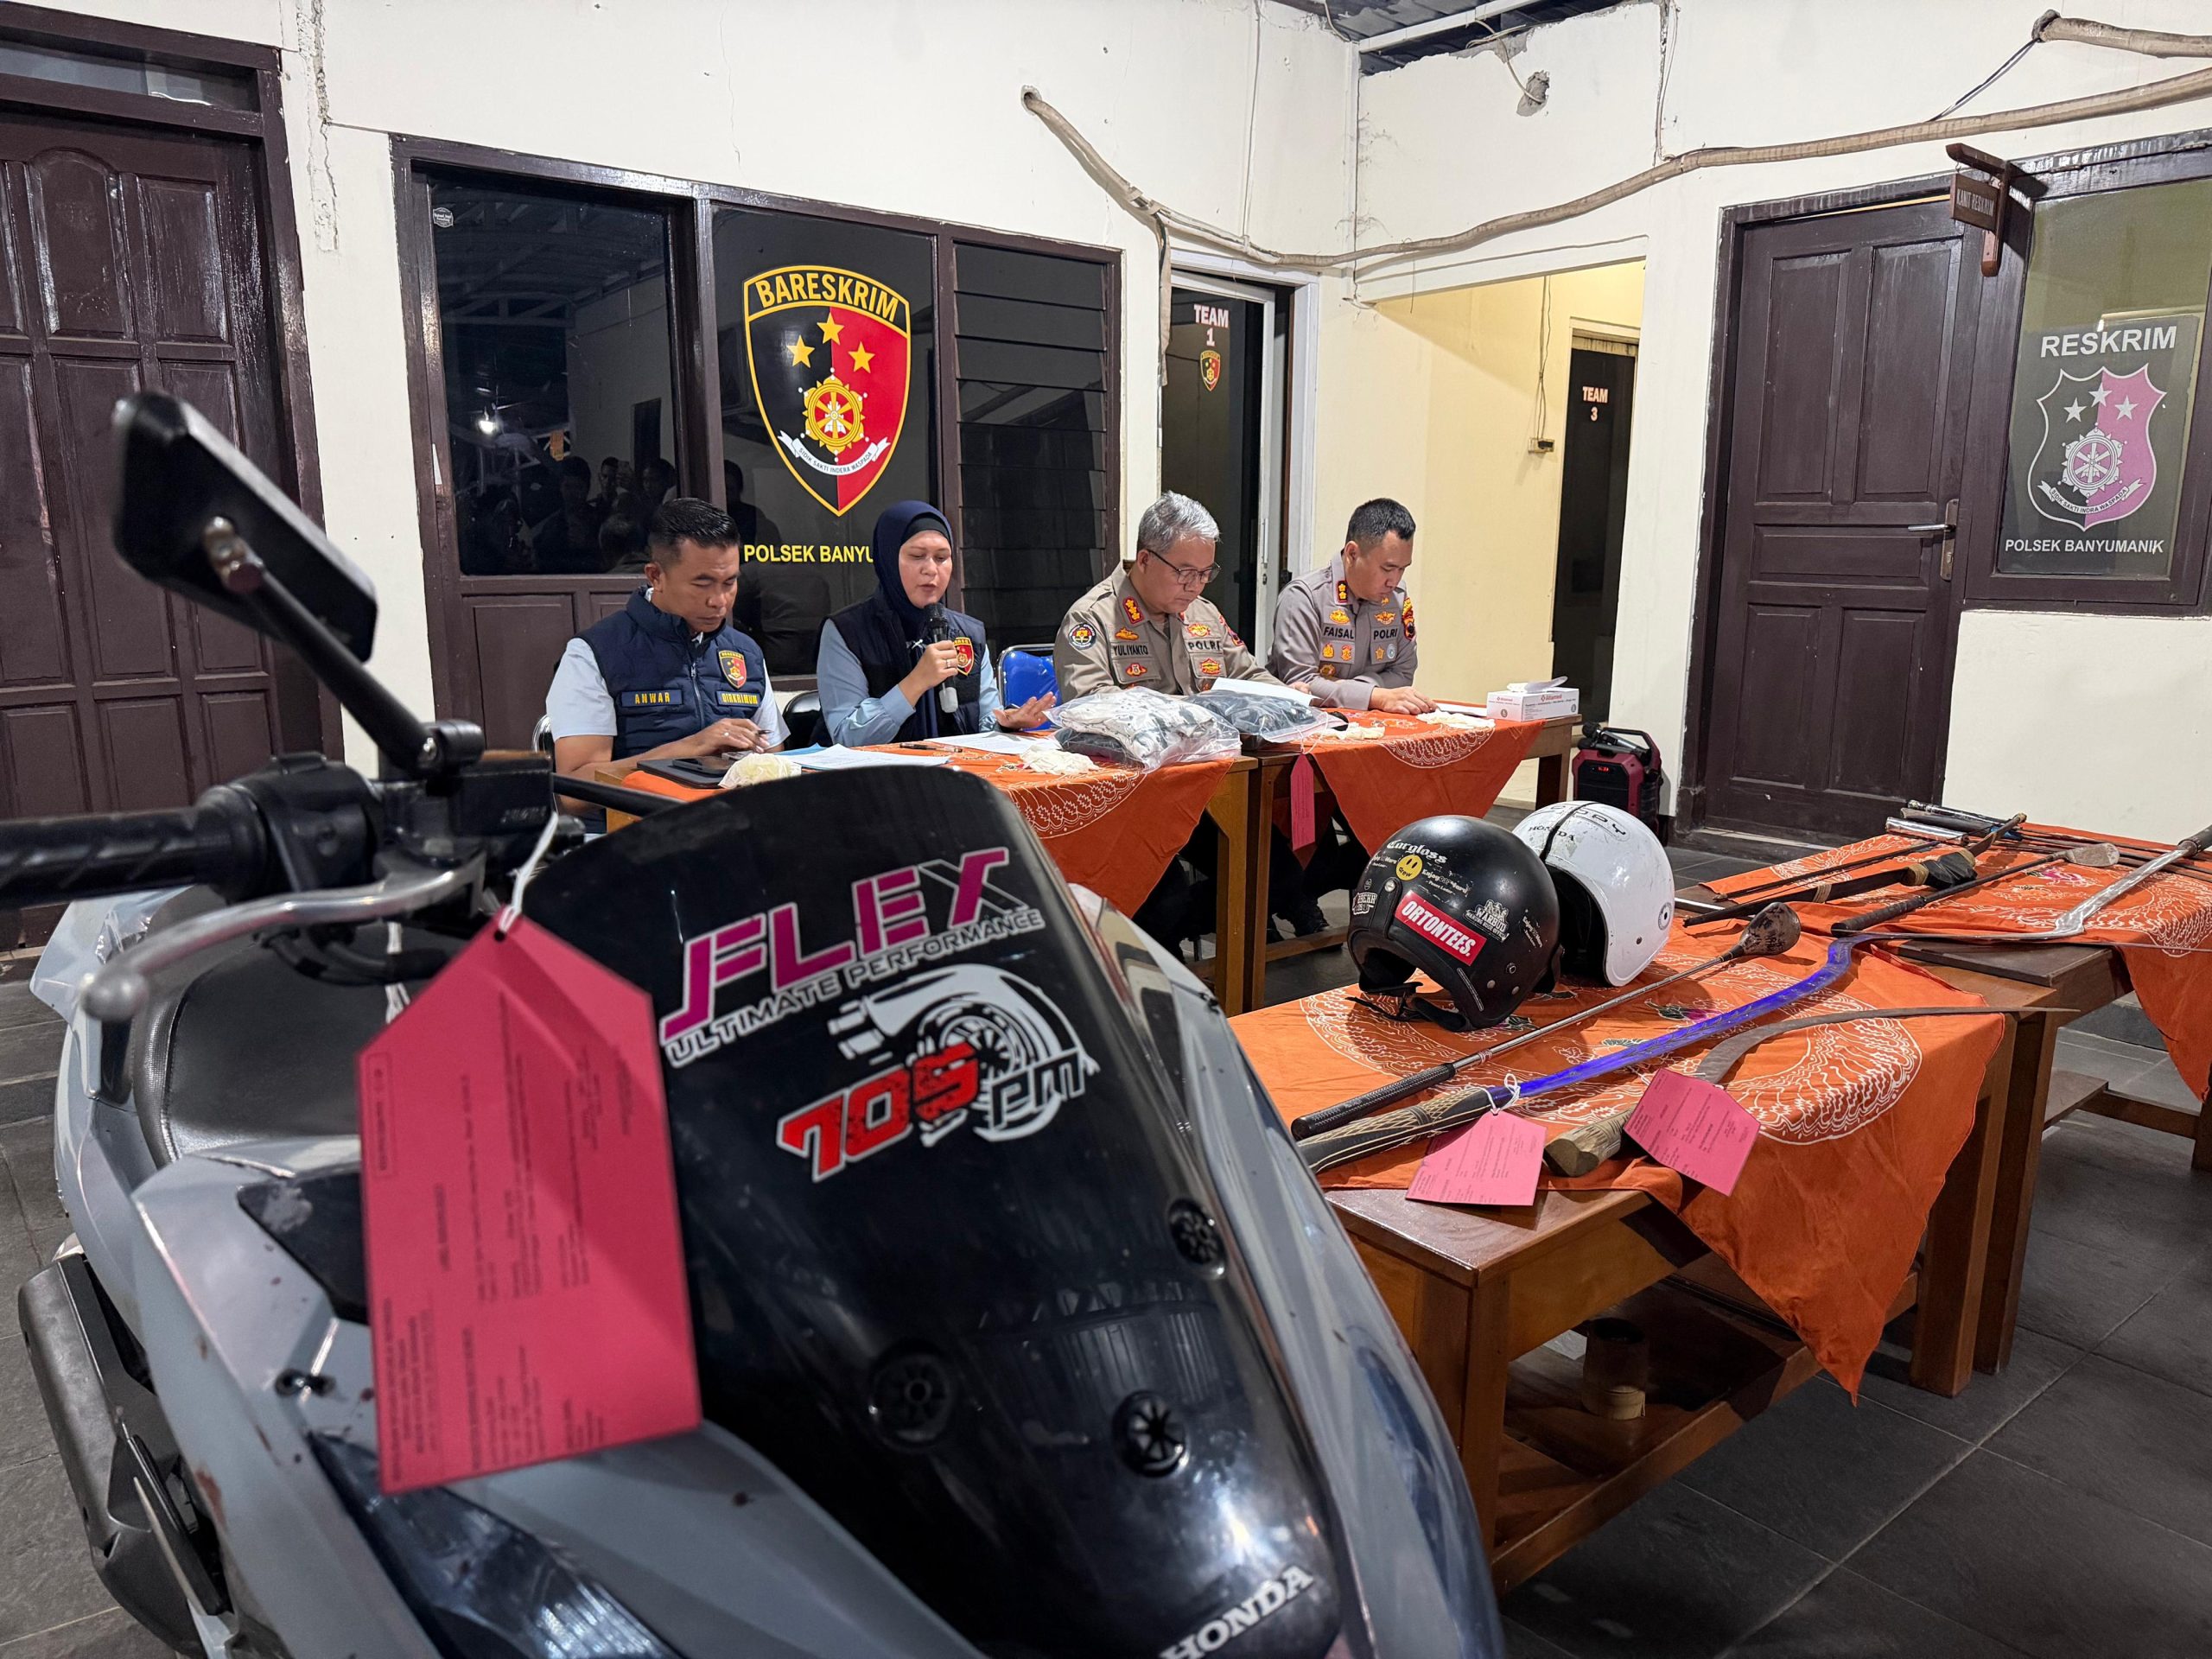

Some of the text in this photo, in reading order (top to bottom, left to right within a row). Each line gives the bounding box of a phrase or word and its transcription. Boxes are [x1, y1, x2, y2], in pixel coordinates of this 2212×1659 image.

[755, 272, 899, 322] BARESKRIM
[1193, 303, 1229, 328] TEAM
[1206, 327, 1216, 346] 1
[2040, 326, 2177, 359] RESKRIM
[1582, 385, 1609, 404] TEAM
[1591, 406, 1599, 422] 3
[798, 448, 812, 462] SIDIK
[813, 460, 830, 472] SAKTI
[2051, 489, 2063, 504] SIDIK
[2063, 501, 2079, 512] SAKTI
[2099, 489, 2127, 510] WASPADA
[744, 544, 874, 563] POLSEK BANYU
[2005, 538, 2164, 555] POLSEK BANYUMANIK
[1323, 626, 1398, 640] FAISAL POLRI
[1112, 640, 1222, 657] YULIYANTO POLRI
[634, 692, 671, 704] ANWAR
[1476, 907, 1507, 932] WARBUD
[658, 847, 1030, 1046] FLEX
[664, 908, 1046, 1069] ULTIMATE PERFORMANCE
[1158, 1565, 1314, 1659] HONDA
